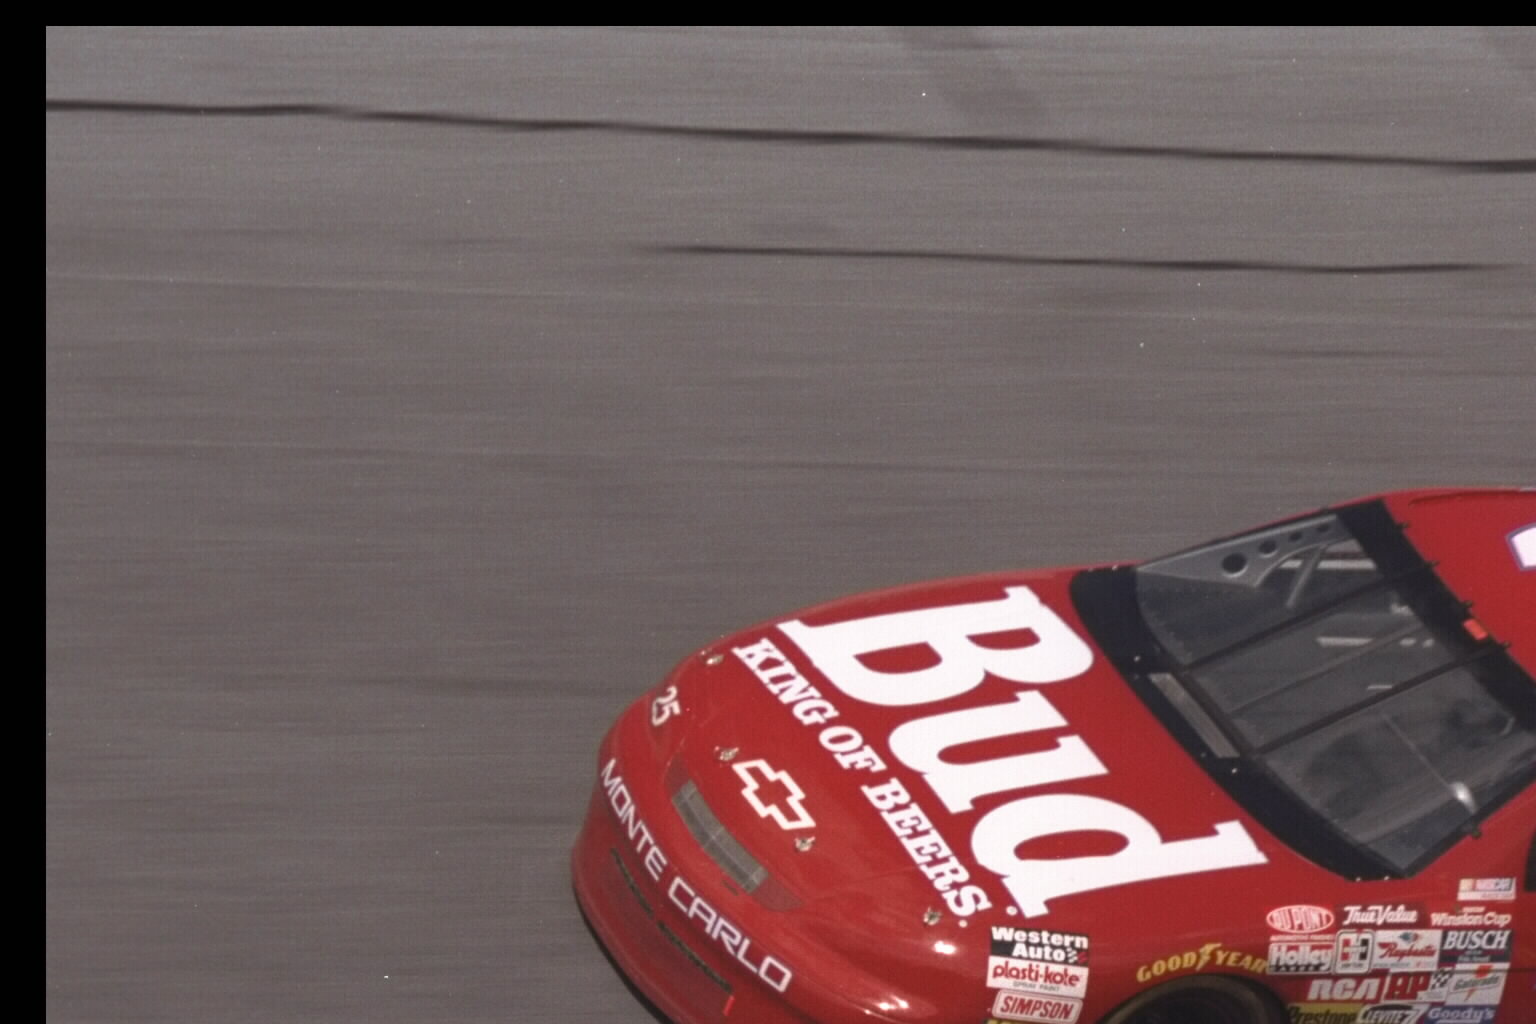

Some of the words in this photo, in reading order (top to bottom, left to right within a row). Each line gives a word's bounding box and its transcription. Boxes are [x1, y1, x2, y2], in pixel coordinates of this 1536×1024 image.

[652, 686, 681, 726] 25
[777, 586, 1268, 918] Bud
[732, 638, 840, 726] KING
[818, 725, 887, 772] OF
[860, 777, 992, 917] BEERS
[601, 758, 668, 882] MONTE
[1483, 911, 1512, 928] Cup
[668, 876, 793, 993] CARLO
[991, 926, 1089, 949] Western
[1443, 929, 1511, 951] BUSCH
[1011, 942, 1066, 962] Auto
[1269, 943, 1333, 972] Holley
[992, 961, 1080, 987] plasti-kote
[1307, 978, 1381, 1000] RCA
[1000, 995, 1075, 1020] SIMPSON
[1428, 1006, 1497, 1023] Goody's
